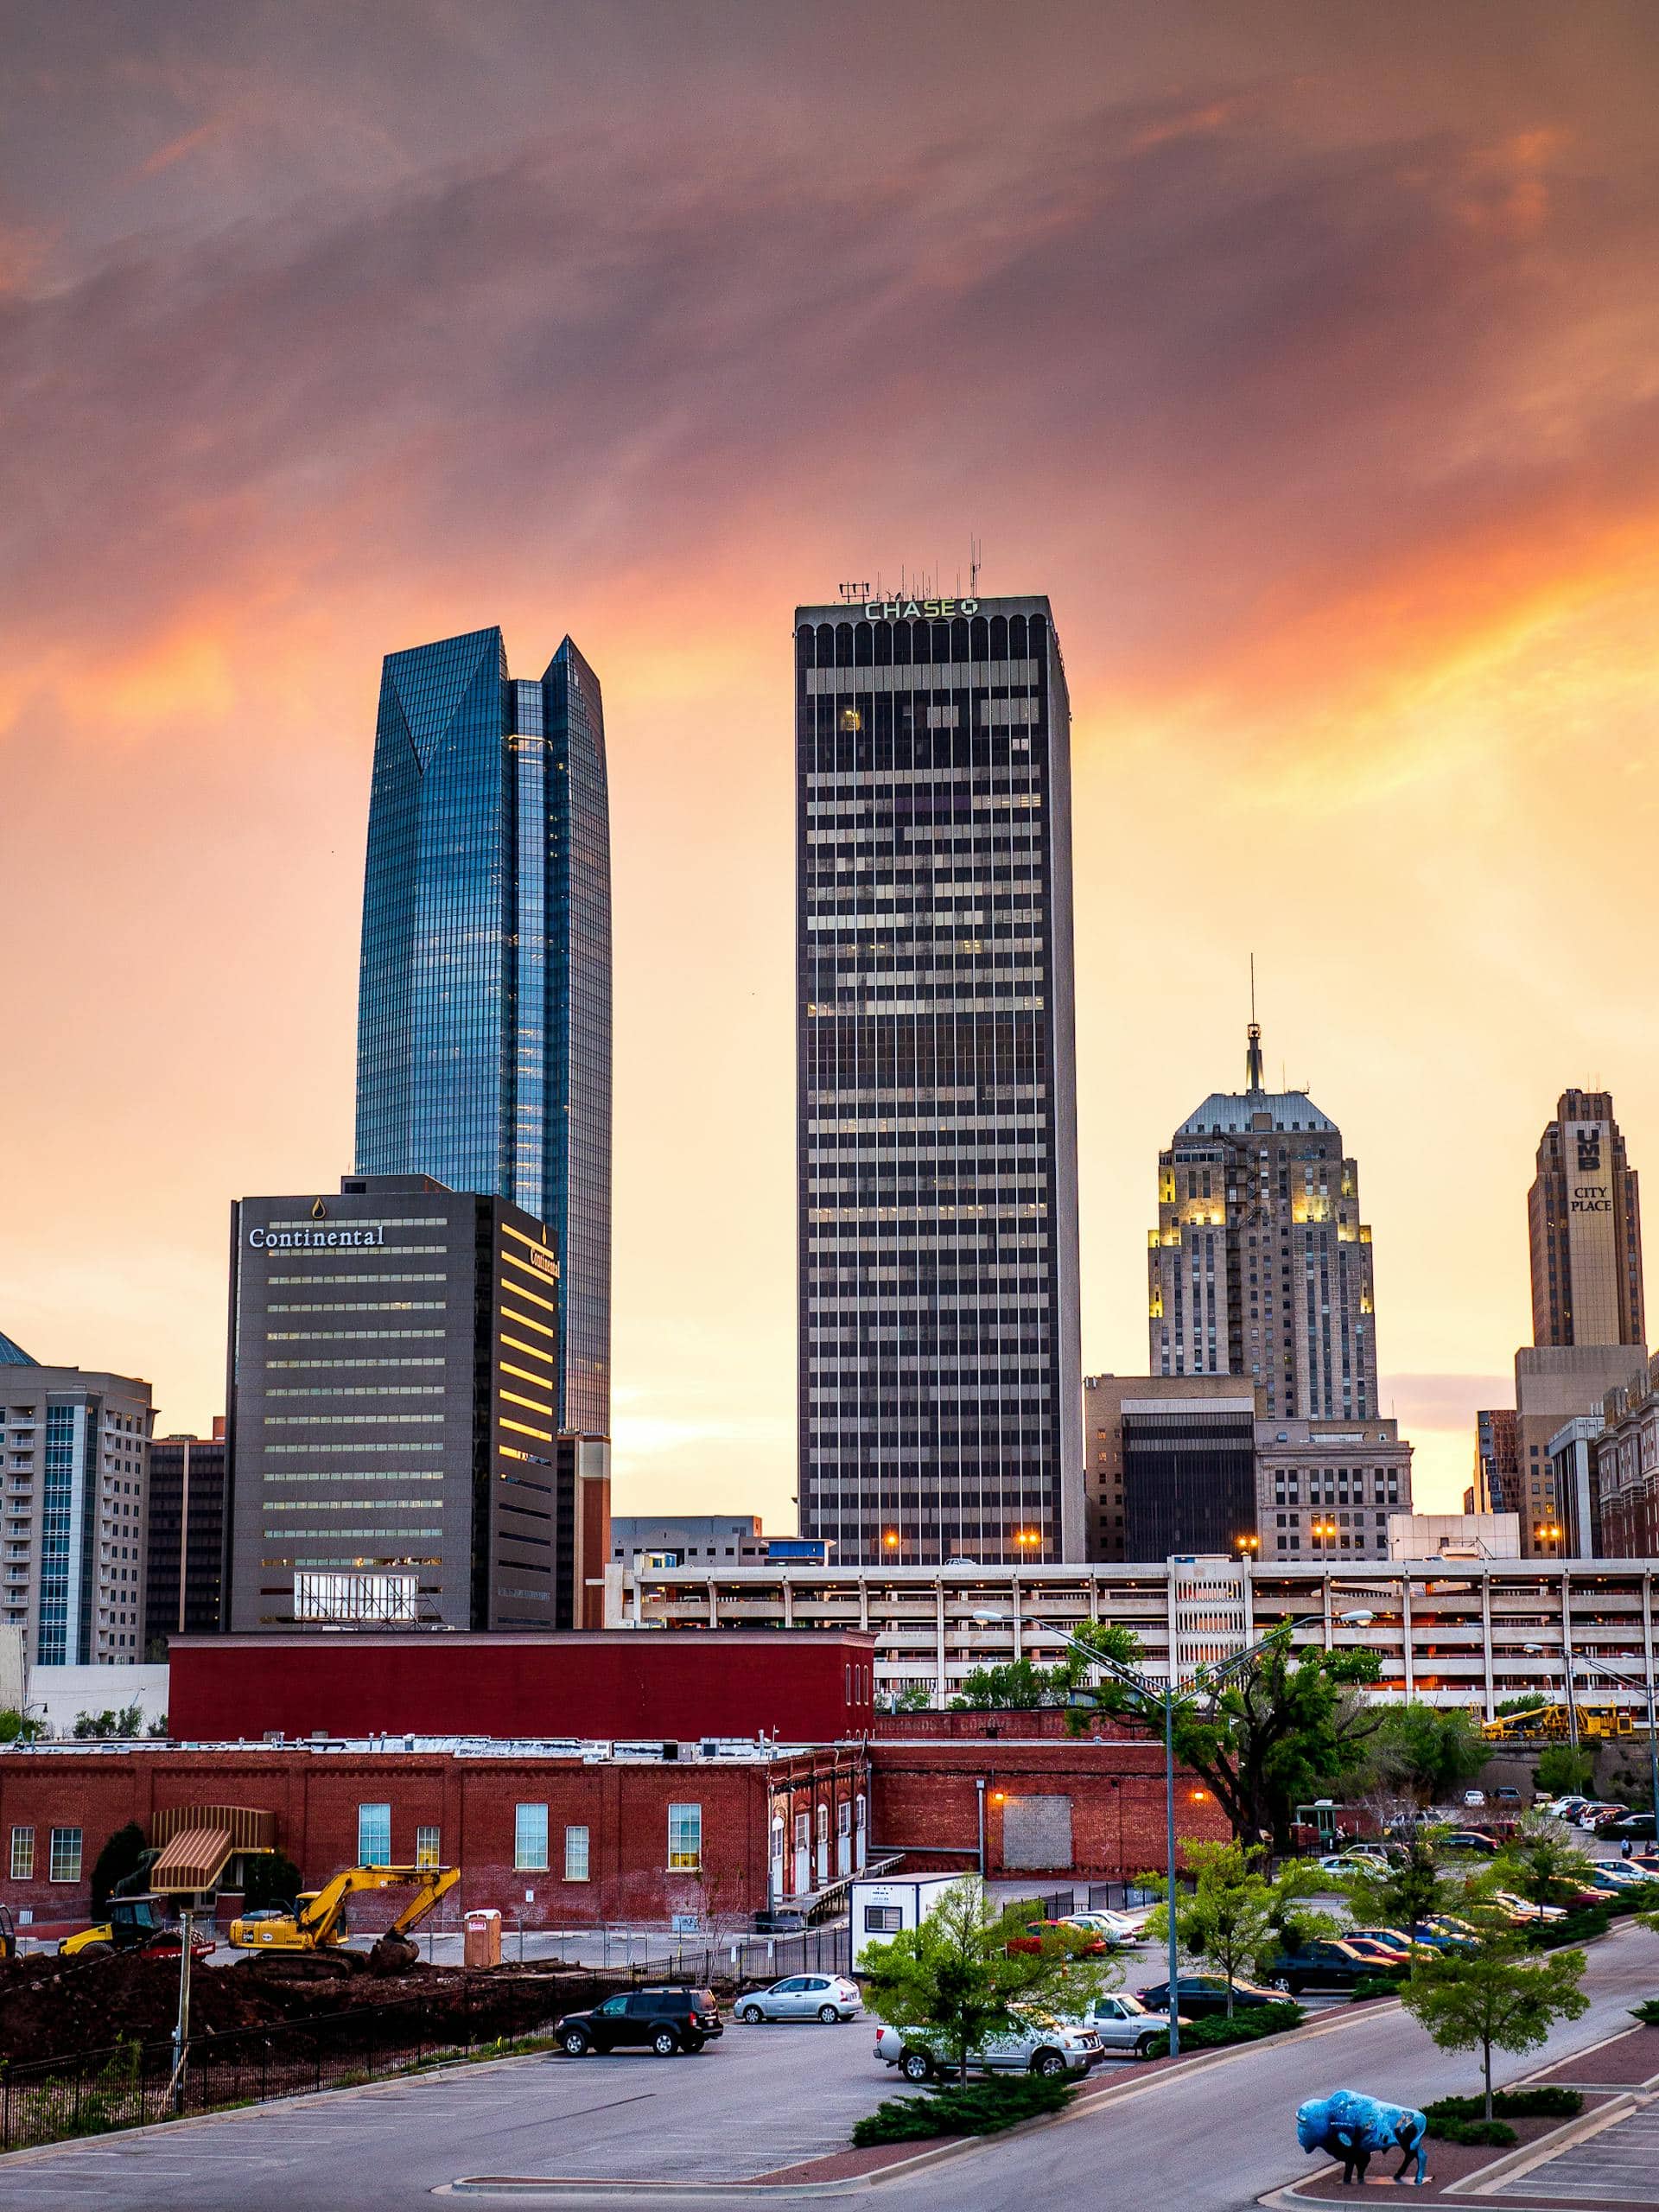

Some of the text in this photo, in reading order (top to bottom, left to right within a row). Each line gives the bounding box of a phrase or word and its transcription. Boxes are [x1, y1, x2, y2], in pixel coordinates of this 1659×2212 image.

[865, 600, 957, 620] CHASE
[1577, 1129, 1600, 1171] UMB
[1574, 1186, 1607, 1198] CITY
[1571, 1200, 1611, 1212] PLACE
[249, 1226, 385, 1248] Continental
[531, 1248, 560, 1279] Continental
